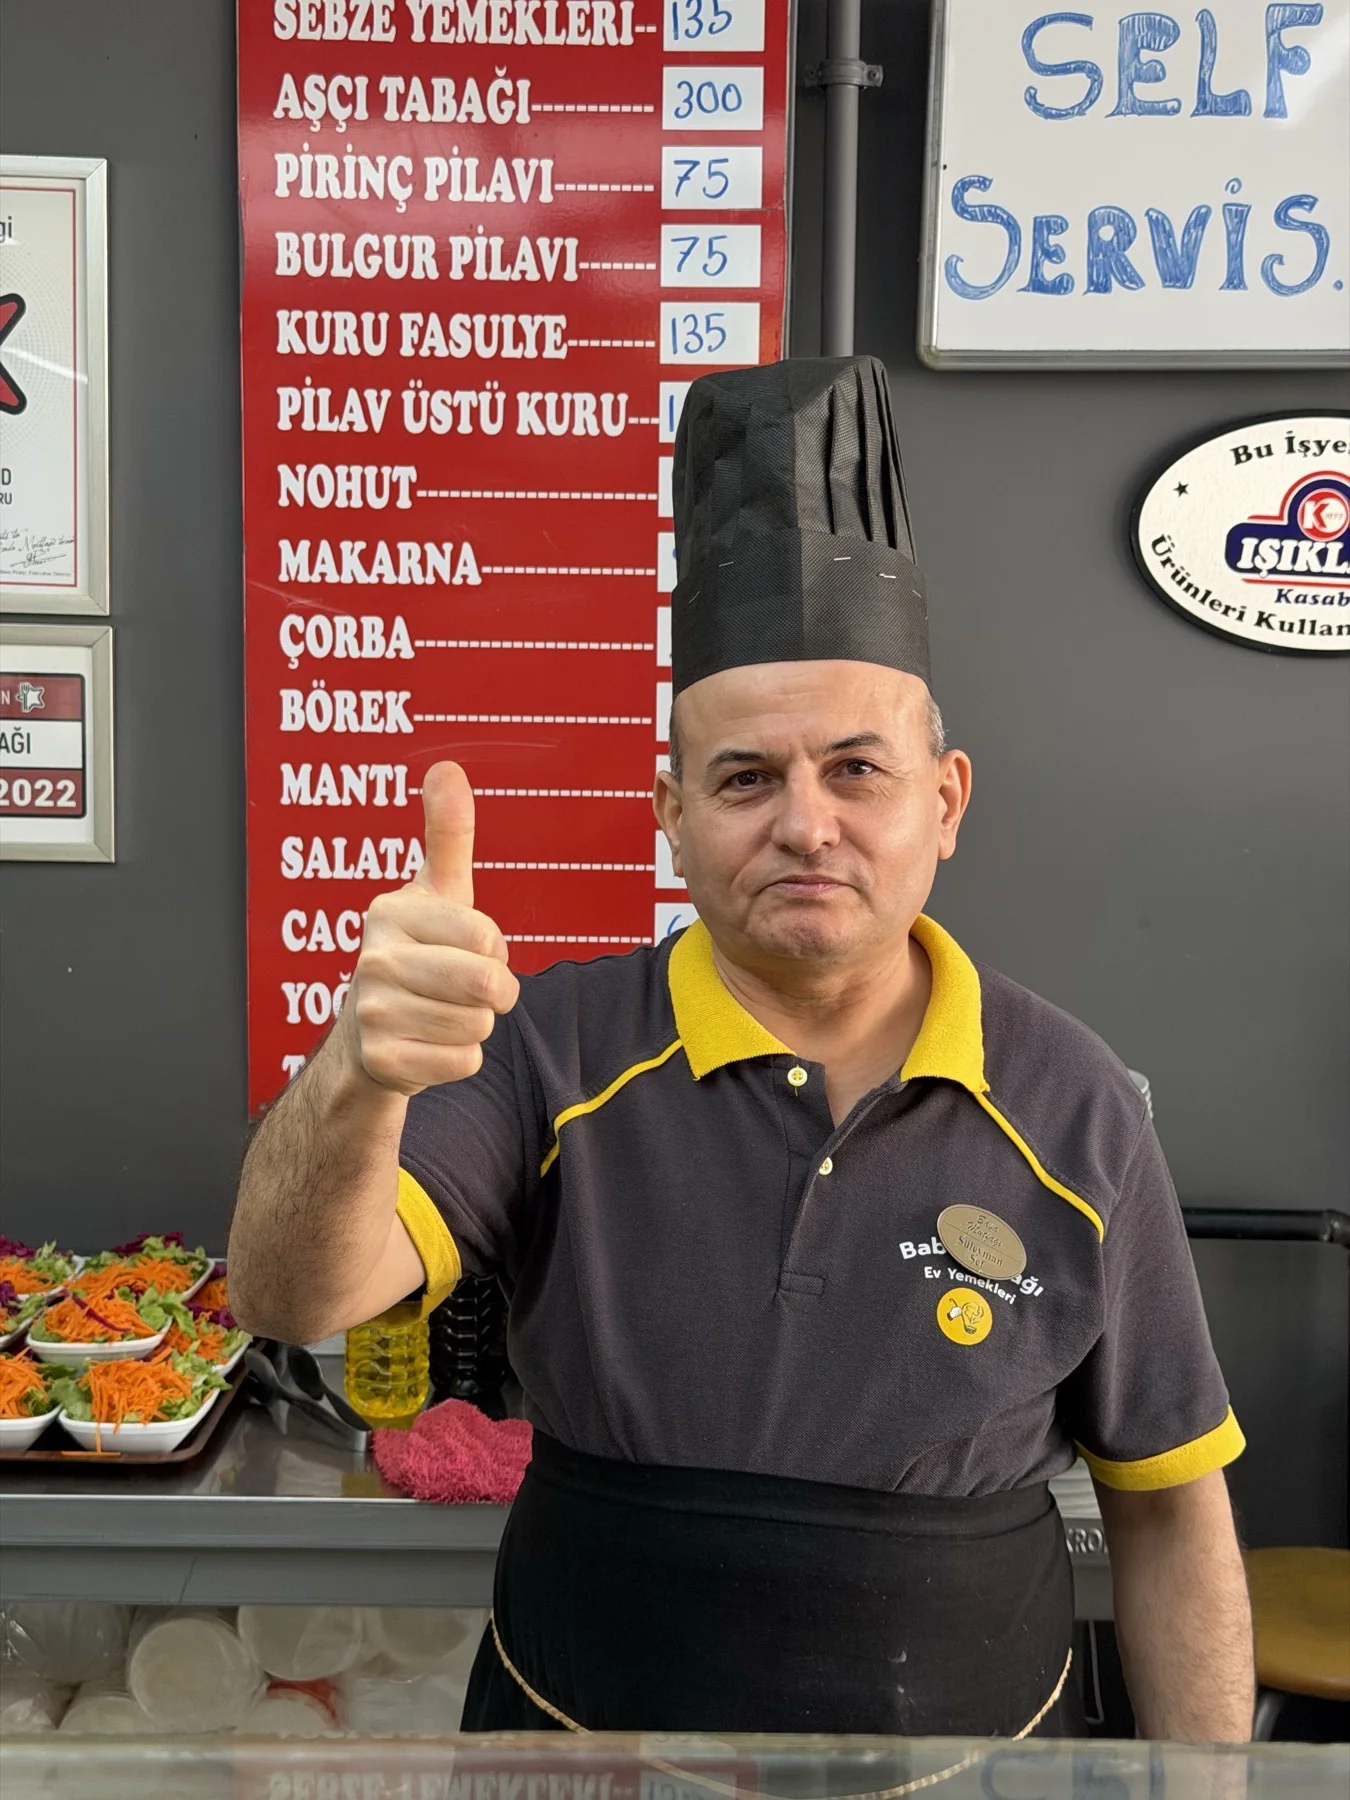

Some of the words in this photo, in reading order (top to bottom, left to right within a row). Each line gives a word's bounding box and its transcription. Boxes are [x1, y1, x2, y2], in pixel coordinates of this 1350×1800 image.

[274, 0, 396, 42] SEBZE
[673, 0, 731, 39] 135
[1021, 3, 1324, 120] SELF
[273, 74, 368, 133] AŞÇI
[380, 67, 530, 124] TABAĞI
[675, 81, 742, 118] 300
[274, 143, 413, 213] PİRİNÇ
[424, 145, 554, 203] PİLAVI
[673, 158, 729, 199] 75
[275, 231, 439, 279] BULGUR
[449, 224, 578, 281] PİLAVI
[670, 235, 728, 276] 75
[277, 310, 389, 356] KURU
[400, 313, 567, 359] FASULYE
[672, 313, 726, 352] 135
[277, 377, 391, 432] PİLAV
[402, 380, 506, 435] ÜSTÜ
[517, 392, 628, 436] KURU
[1230, 444, 1274, 466] Bu
[1284, 430, 1350, 458] İşye
[278, 464, 417, 509] NOHUT
[279, 540, 481, 585] MAKARNA
[1151, 534, 1247, 622] Ürünleri
[1236, 537, 1350, 578] IŞIKL
[280, 614, 414, 669] ÇORBA
[280, 680, 413, 733] BÖREK
[281, 764, 407, 806] MANTI
[281, 836, 423, 880] SALATA
[281, 908, 367, 953] CAC
[899, 1237, 947, 1259] Bab
[1010, 1275, 1044, 1298] ağı
[923, 1266, 942, 1279] Ev
[946, 1267, 1018, 1304] Yemekleri
